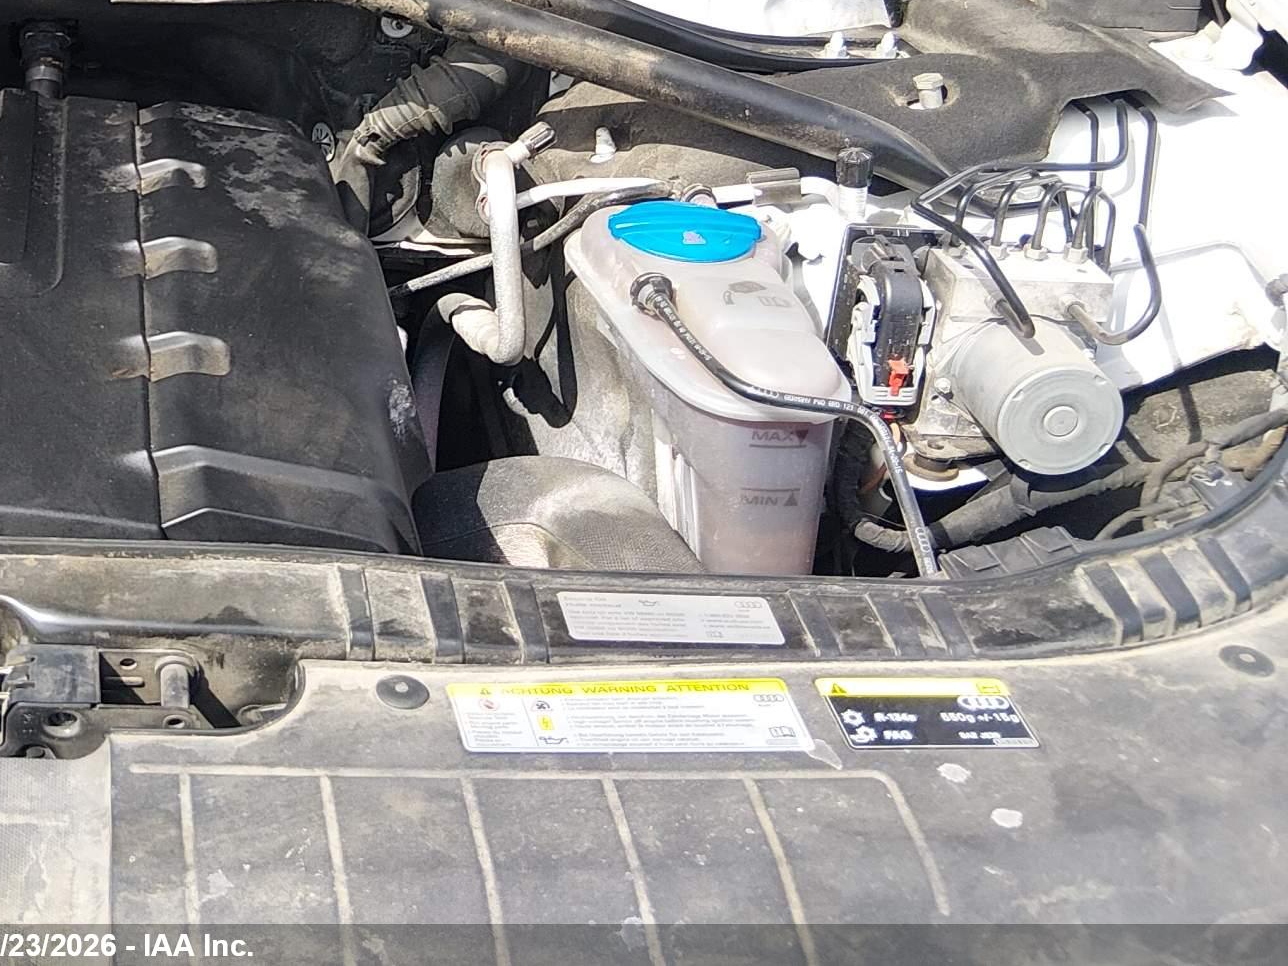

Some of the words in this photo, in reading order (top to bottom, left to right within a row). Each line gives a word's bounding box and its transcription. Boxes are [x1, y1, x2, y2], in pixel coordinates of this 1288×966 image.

[752, 430, 794, 441] MAX
[741, 495, 778, 506] MIN
[582, 686, 657, 694] WARNING
[666, 683, 750, 692] ATTENTION
